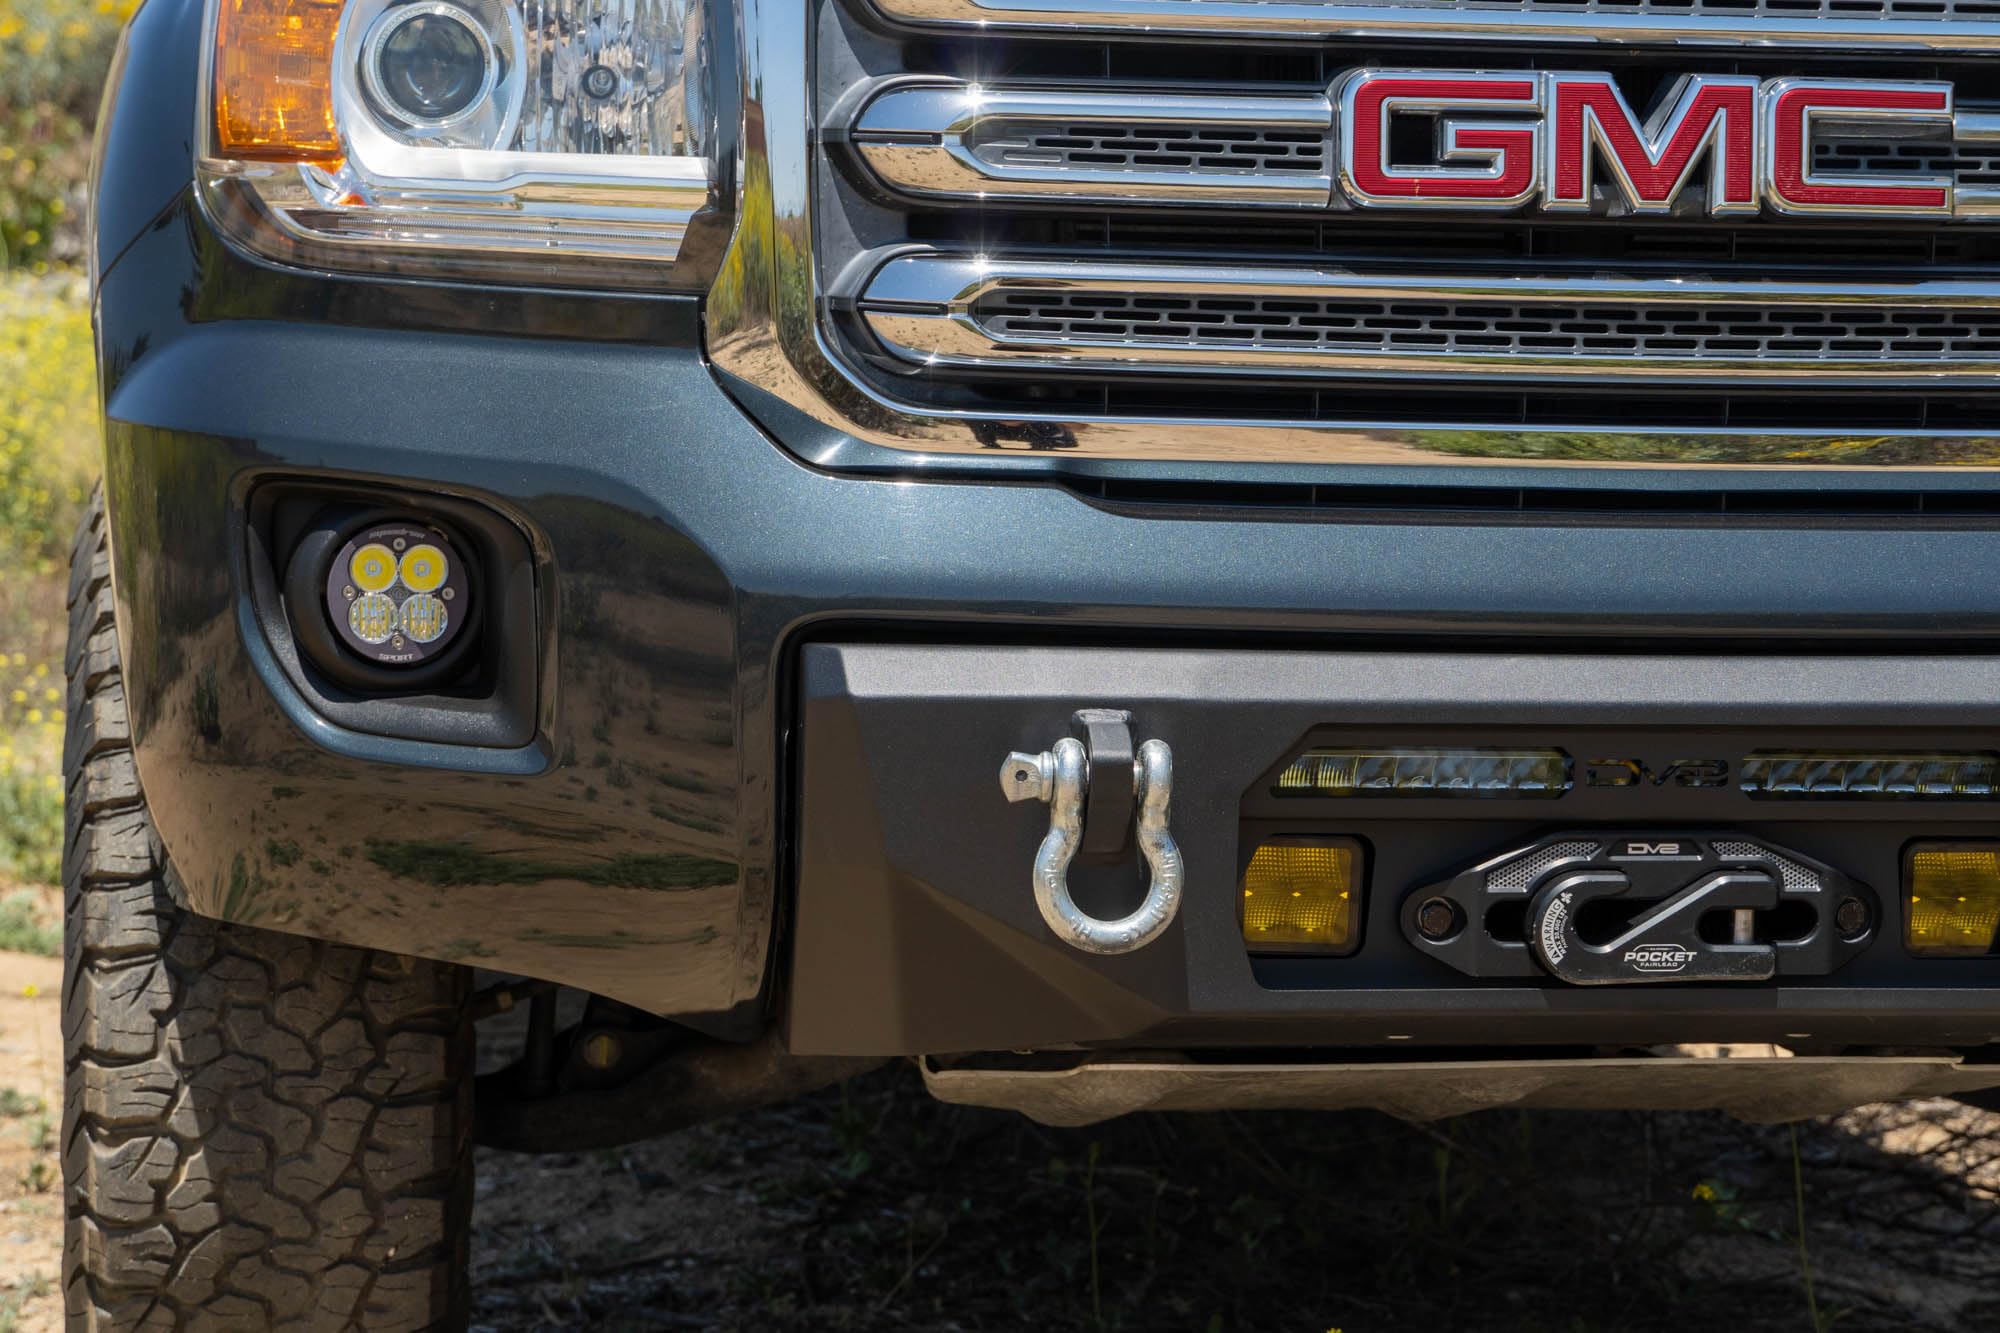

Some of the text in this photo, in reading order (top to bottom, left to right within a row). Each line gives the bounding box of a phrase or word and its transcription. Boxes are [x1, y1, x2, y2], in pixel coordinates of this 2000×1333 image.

[1339, 68, 1954, 216] GMC
[1543, 902, 1562, 953] WARNING
[1624, 951, 1698, 962] POCKET
